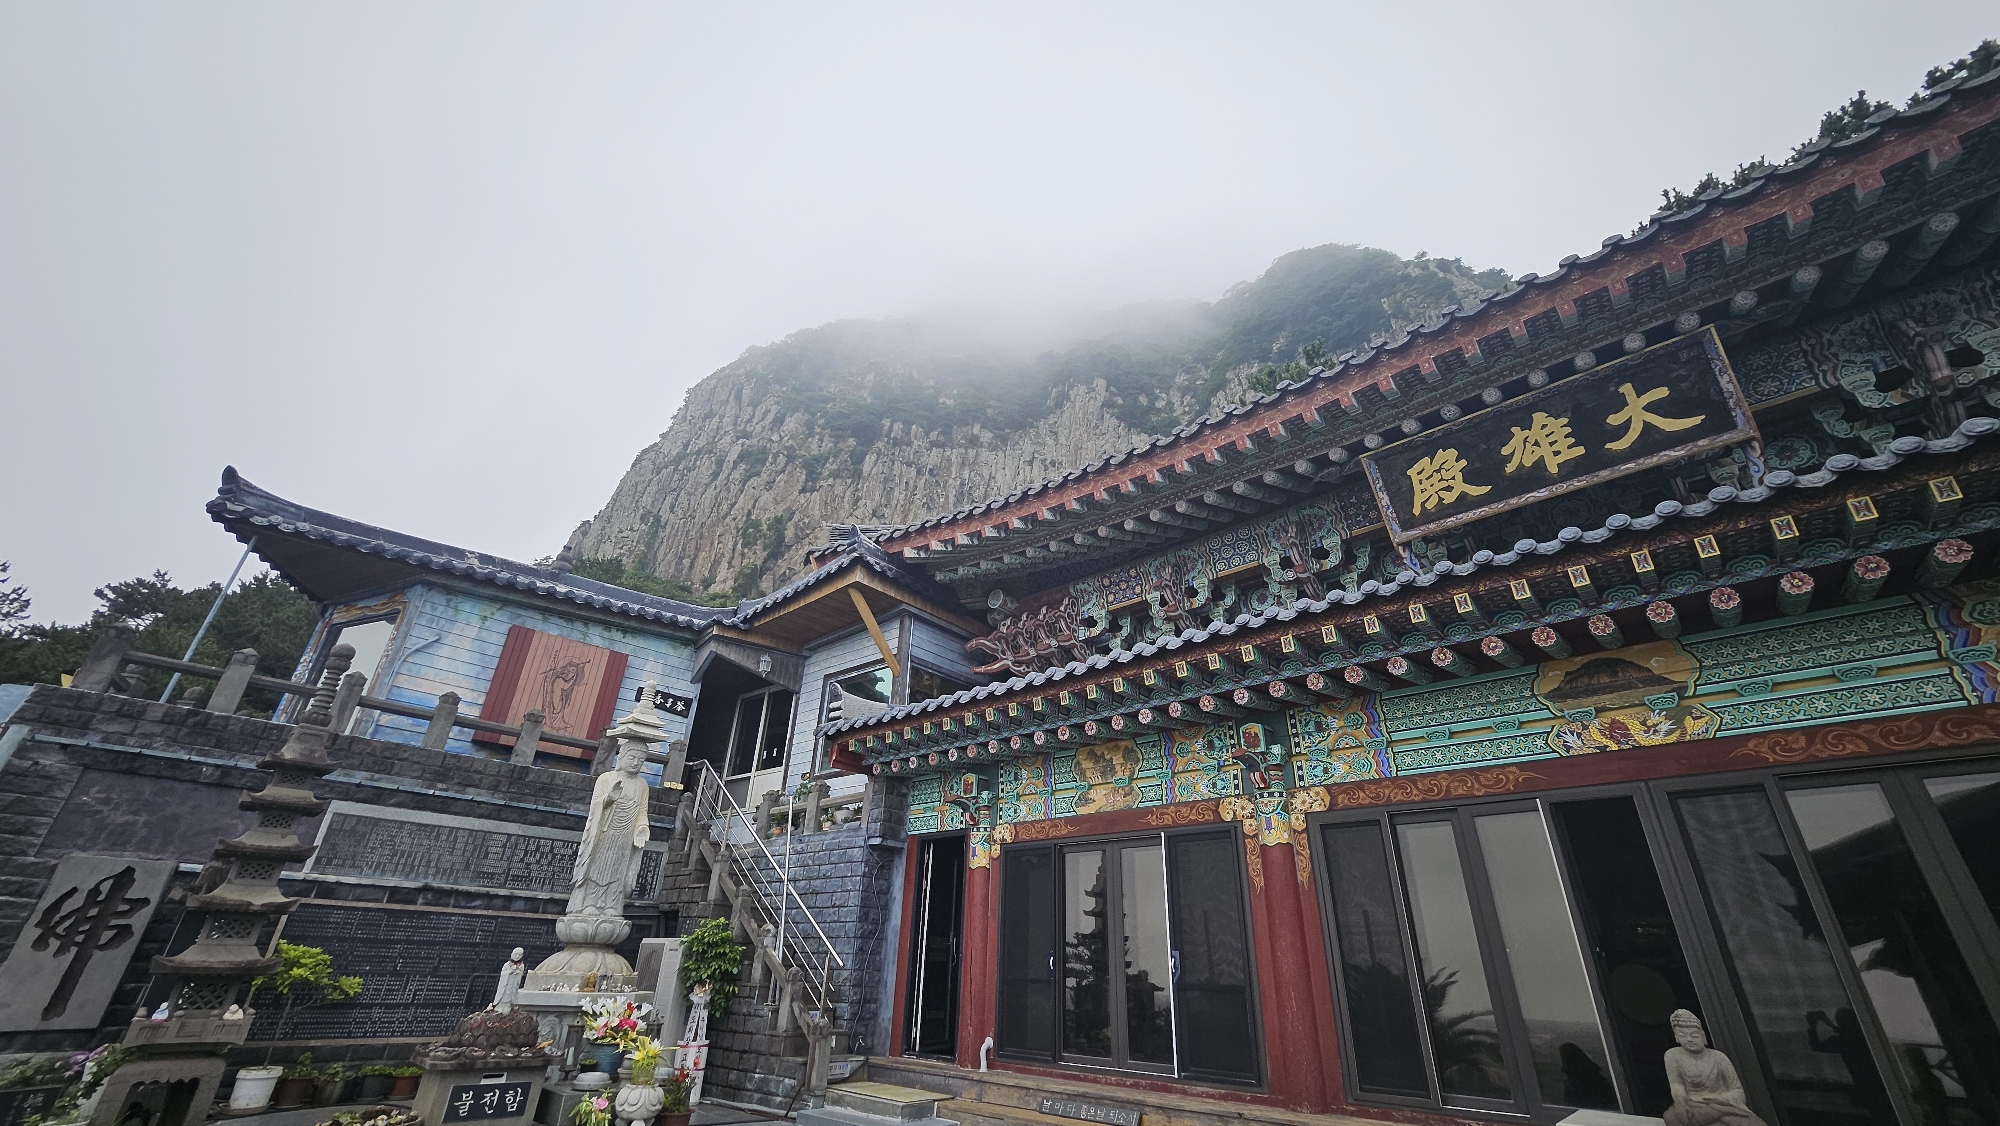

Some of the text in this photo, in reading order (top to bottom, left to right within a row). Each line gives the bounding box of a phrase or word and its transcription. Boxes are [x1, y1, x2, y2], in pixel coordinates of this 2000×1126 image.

[1406, 382, 1706, 516] 大雄殿
[31, 865, 151, 1021] 佛
[453, 1087, 524, 1117] 불전함
